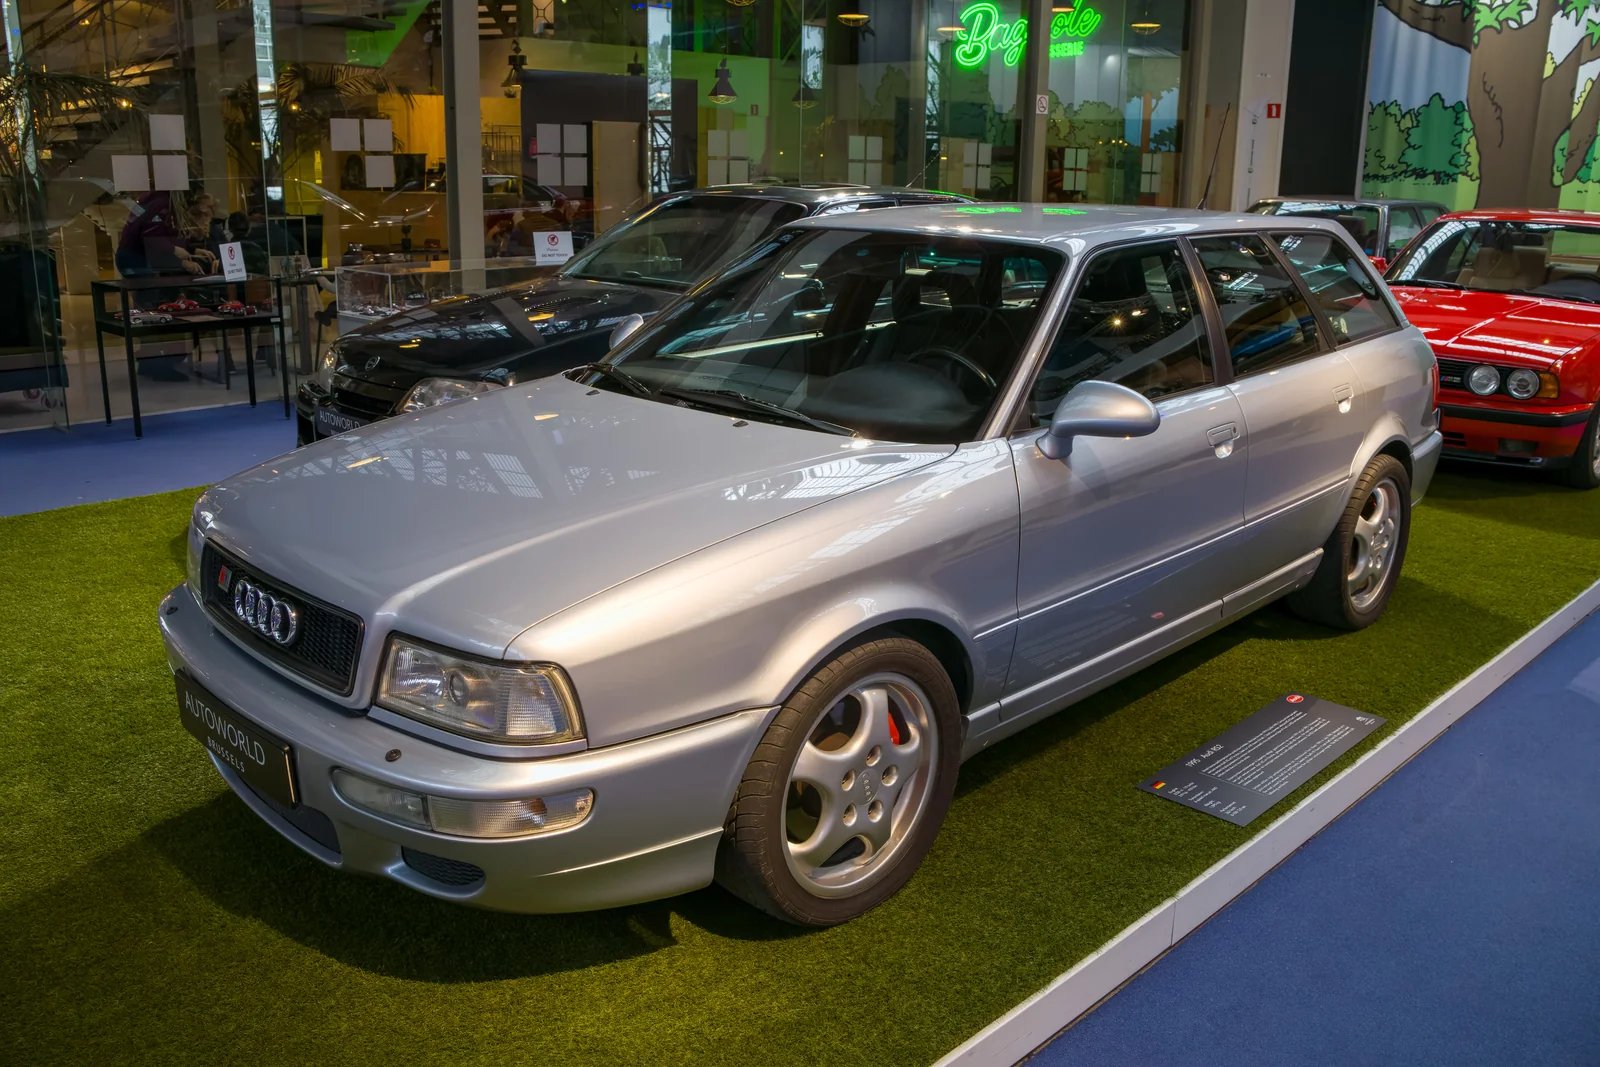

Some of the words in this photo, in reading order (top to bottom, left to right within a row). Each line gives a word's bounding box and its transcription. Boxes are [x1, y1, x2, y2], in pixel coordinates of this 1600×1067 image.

[320, 410, 361, 430] AUTOWORLD
[185, 690, 266, 766] AUTOWORLD
[207, 736, 245, 773] BRUSSELS
[1185, 758, 1201, 768] 1995
[1200, 750, 1215, 759] Audi
